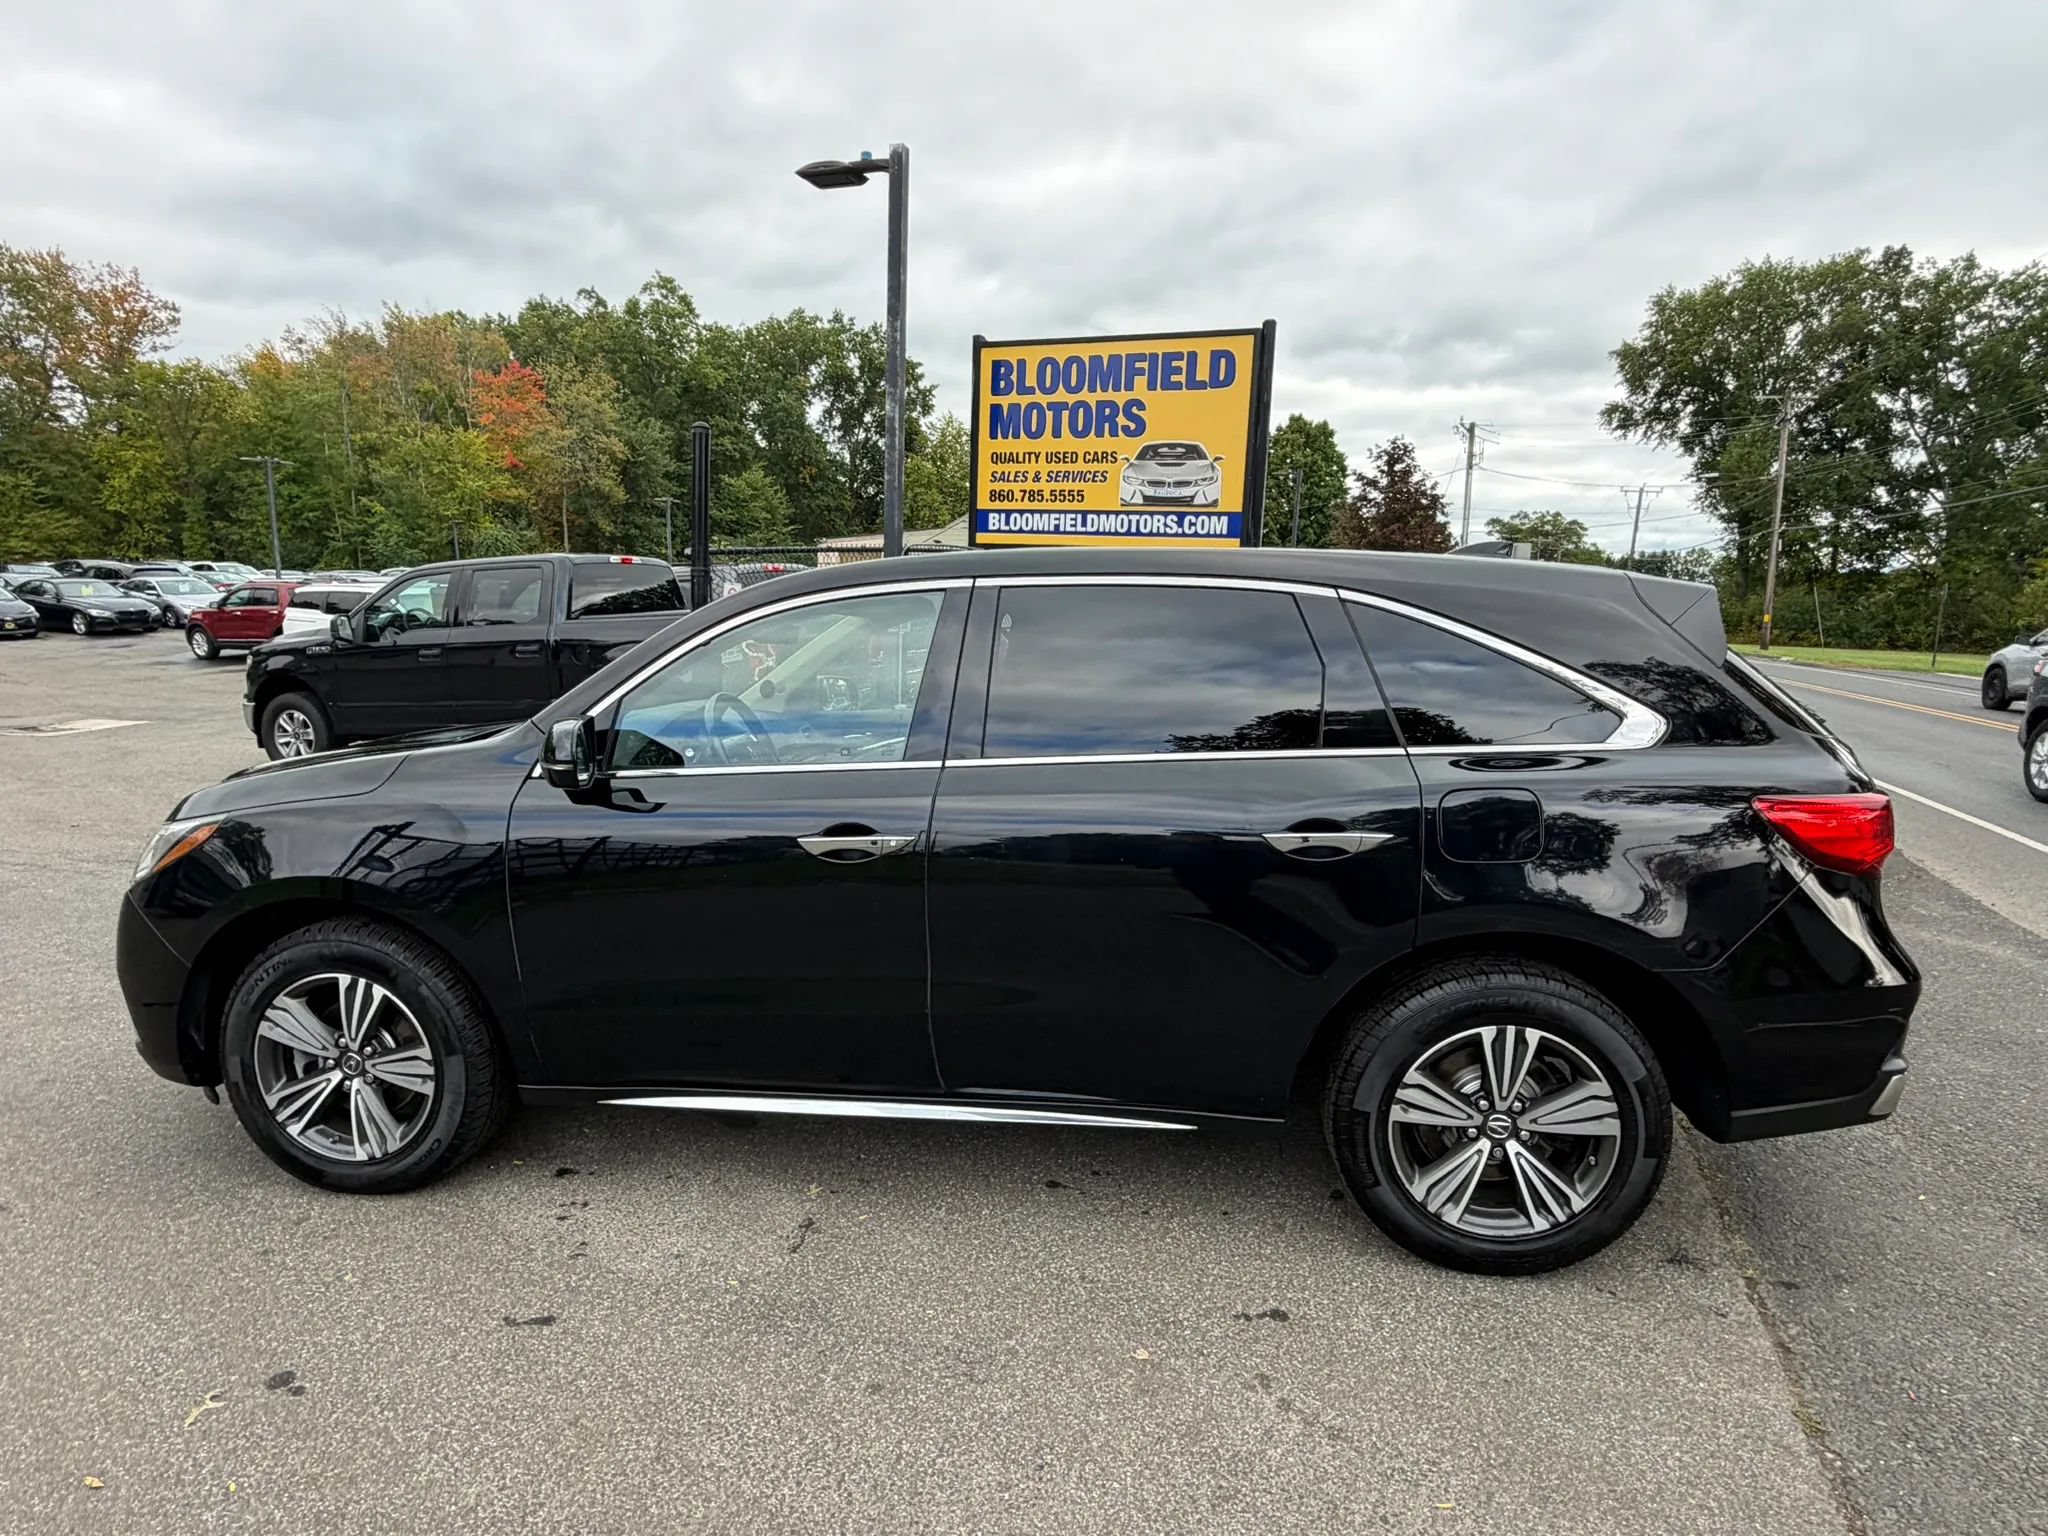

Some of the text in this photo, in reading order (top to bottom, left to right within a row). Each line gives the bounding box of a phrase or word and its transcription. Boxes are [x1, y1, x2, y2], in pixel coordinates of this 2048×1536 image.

[990, 349, 1237, 397] BLOOMFIELD
[989, 398, 1147, 440] MOTORS
[990, 450, 1118, 465] QUALITY USED CARS
[989, 470, 1109, 483] SALES & SERVICES
[989, 489, 1085, 503] 860.785.5555
[988, 512, 1229, 536] BLOOMFIELDMOTORS.COM
